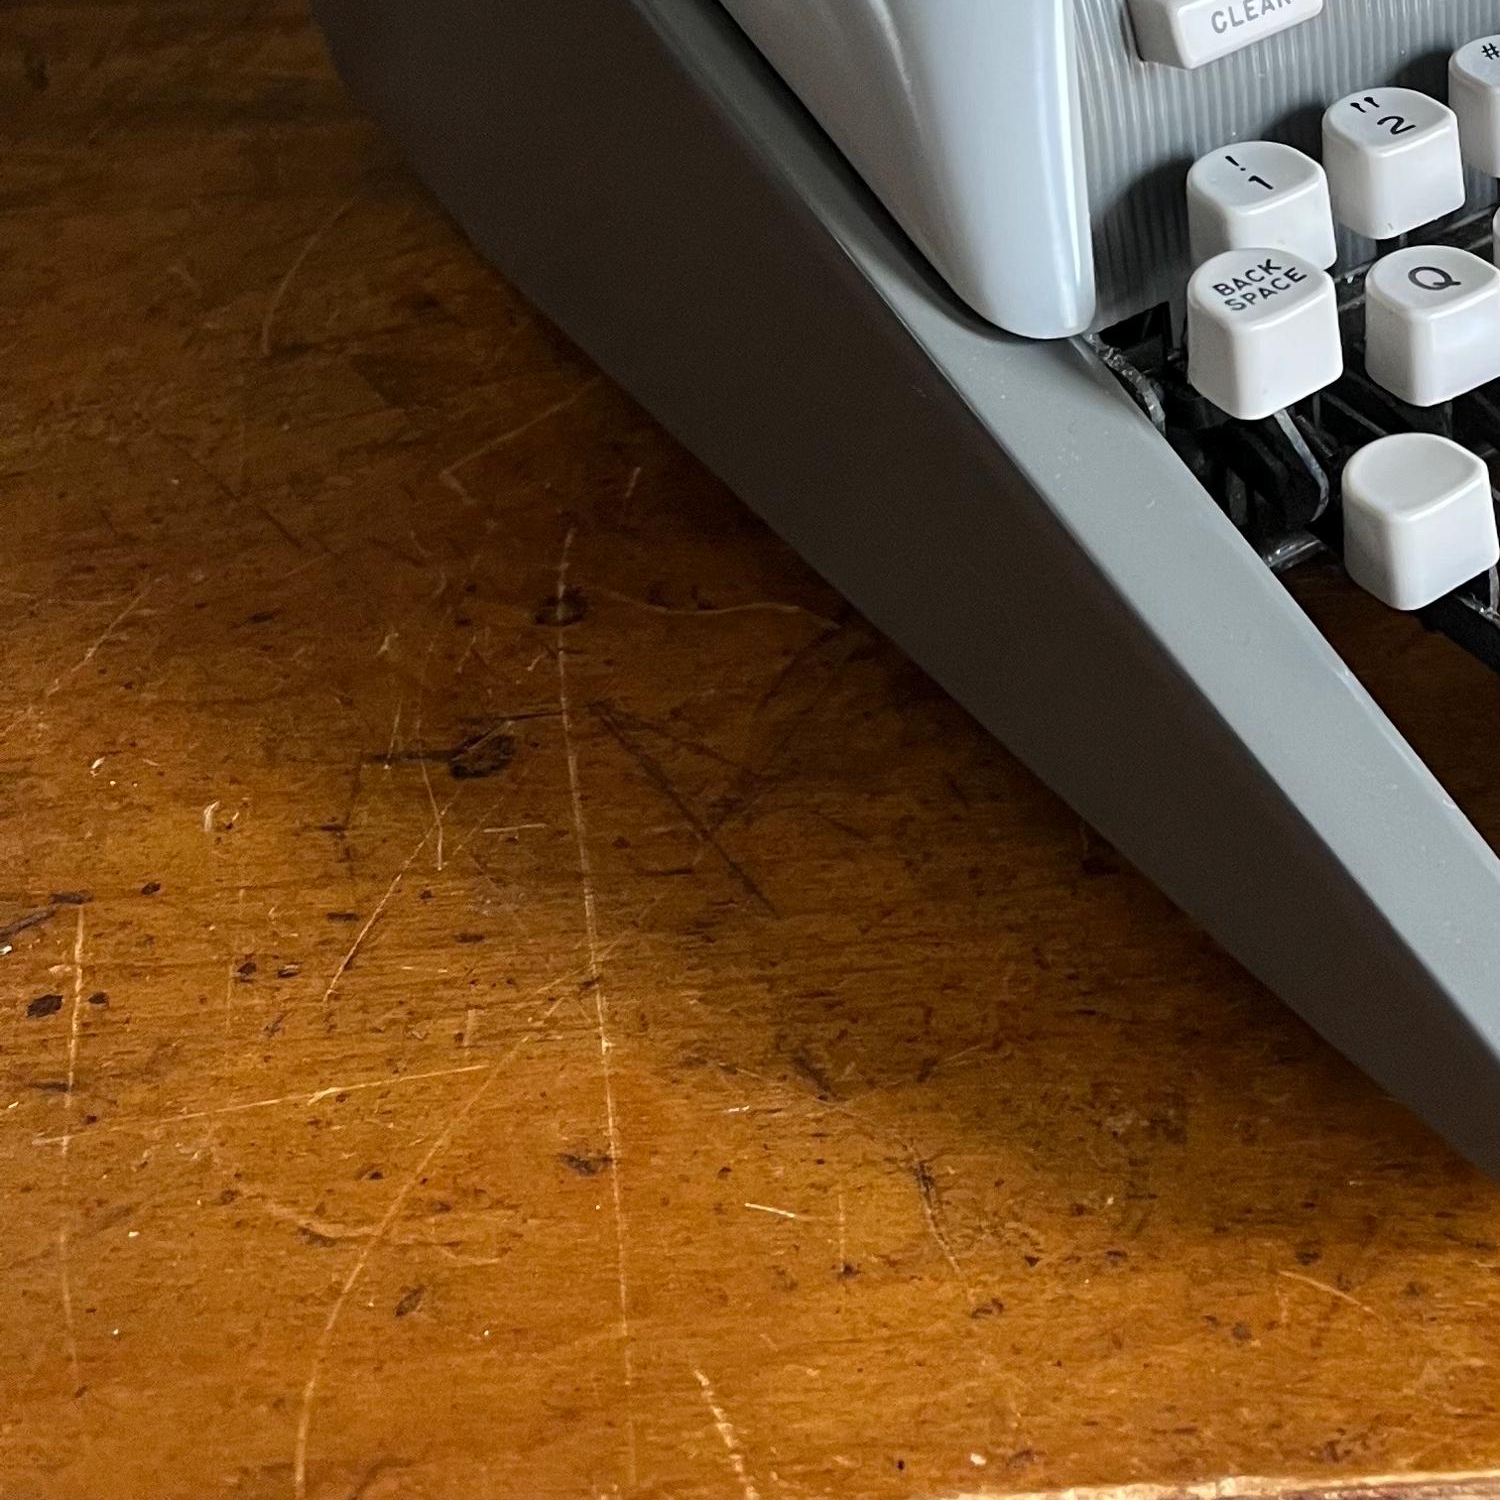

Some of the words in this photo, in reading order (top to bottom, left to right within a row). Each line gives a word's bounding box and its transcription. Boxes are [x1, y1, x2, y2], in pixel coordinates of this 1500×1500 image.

[1481, 42, 1500, 61] #
[1376, 115, 1417, 136] 2
[1247, 175, 1274, 190] 1
[1212, 257, 1283, 297] BACK
[1407, 266, 1462, 291] Q
[1223, 266, 1308, 313] SPACE
